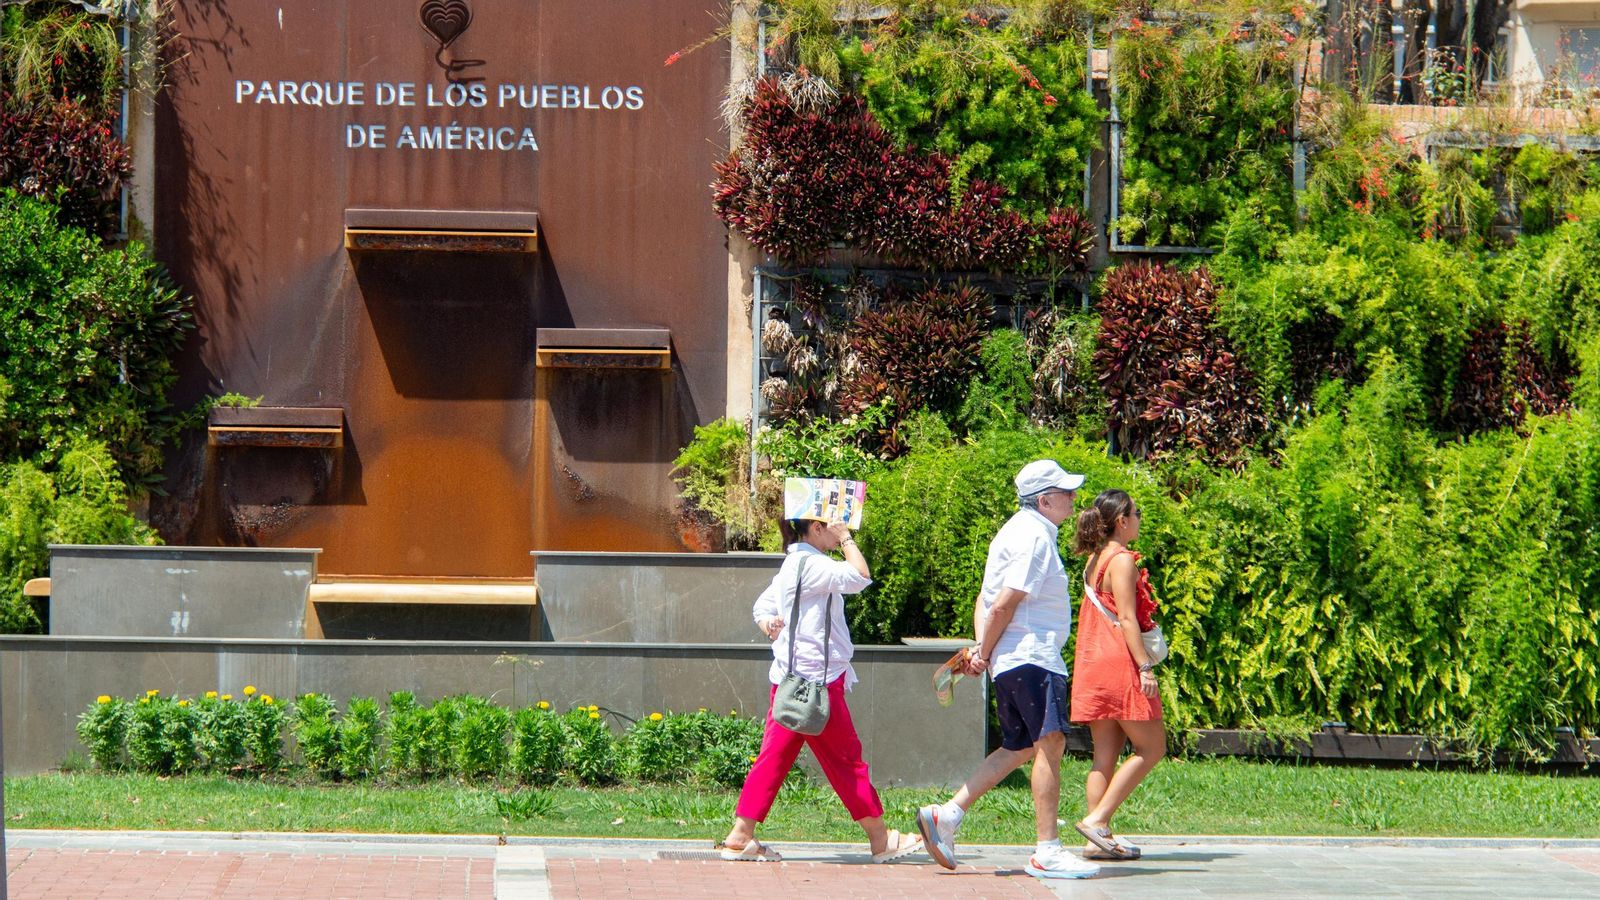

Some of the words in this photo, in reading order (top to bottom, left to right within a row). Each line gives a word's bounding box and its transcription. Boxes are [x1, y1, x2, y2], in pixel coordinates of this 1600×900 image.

[236, 80, 365, 108] PARQUE
[376, 82, 416, 107] DE
[427, 83, 488, 109] LOS
[498, 84, 645, 111] PUEBLOS
[346, 124, 386, 149] DE
[397, 122, 539, 152] AMÉRICA
